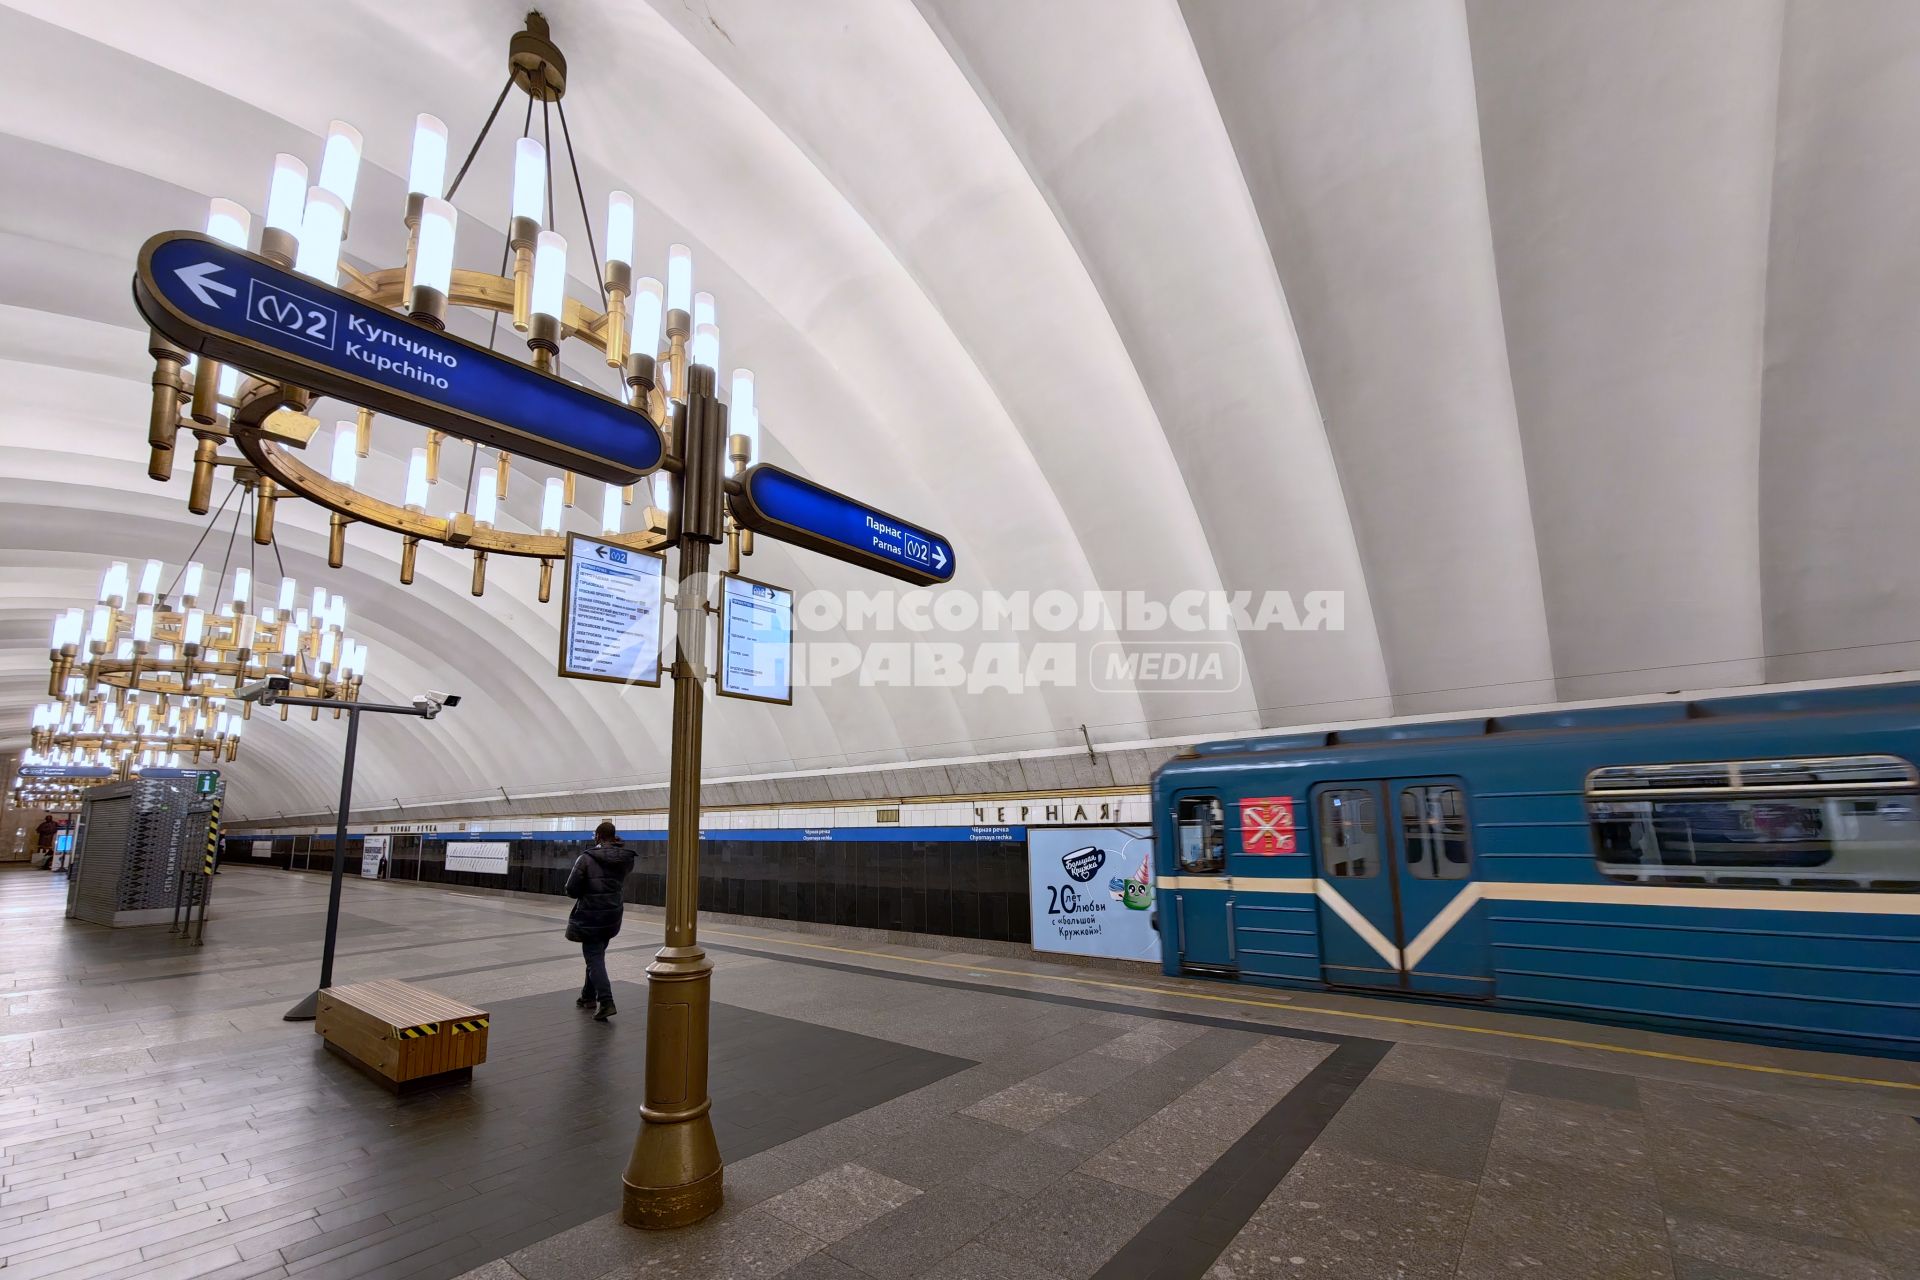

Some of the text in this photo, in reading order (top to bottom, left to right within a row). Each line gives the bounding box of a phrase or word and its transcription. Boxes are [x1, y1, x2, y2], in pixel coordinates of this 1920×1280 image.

[348, 313, 459, 369] Купчино
[345, 340, 450, 391] Kupchino
[867, 516, 902, 539] Парнас
[873, 537, 902, 555] Parnas
[975, 803, 1110, 823] ЧЕРНАЯ
[971, 826, 992, 834] Чёрная
[1065, 855, 1097, 870] Большая
[1071, 862, 1098, 877] Кружка
[1047, 884, 1082, 914] 20 лет
[1075, 900, 1106, 912] любви
